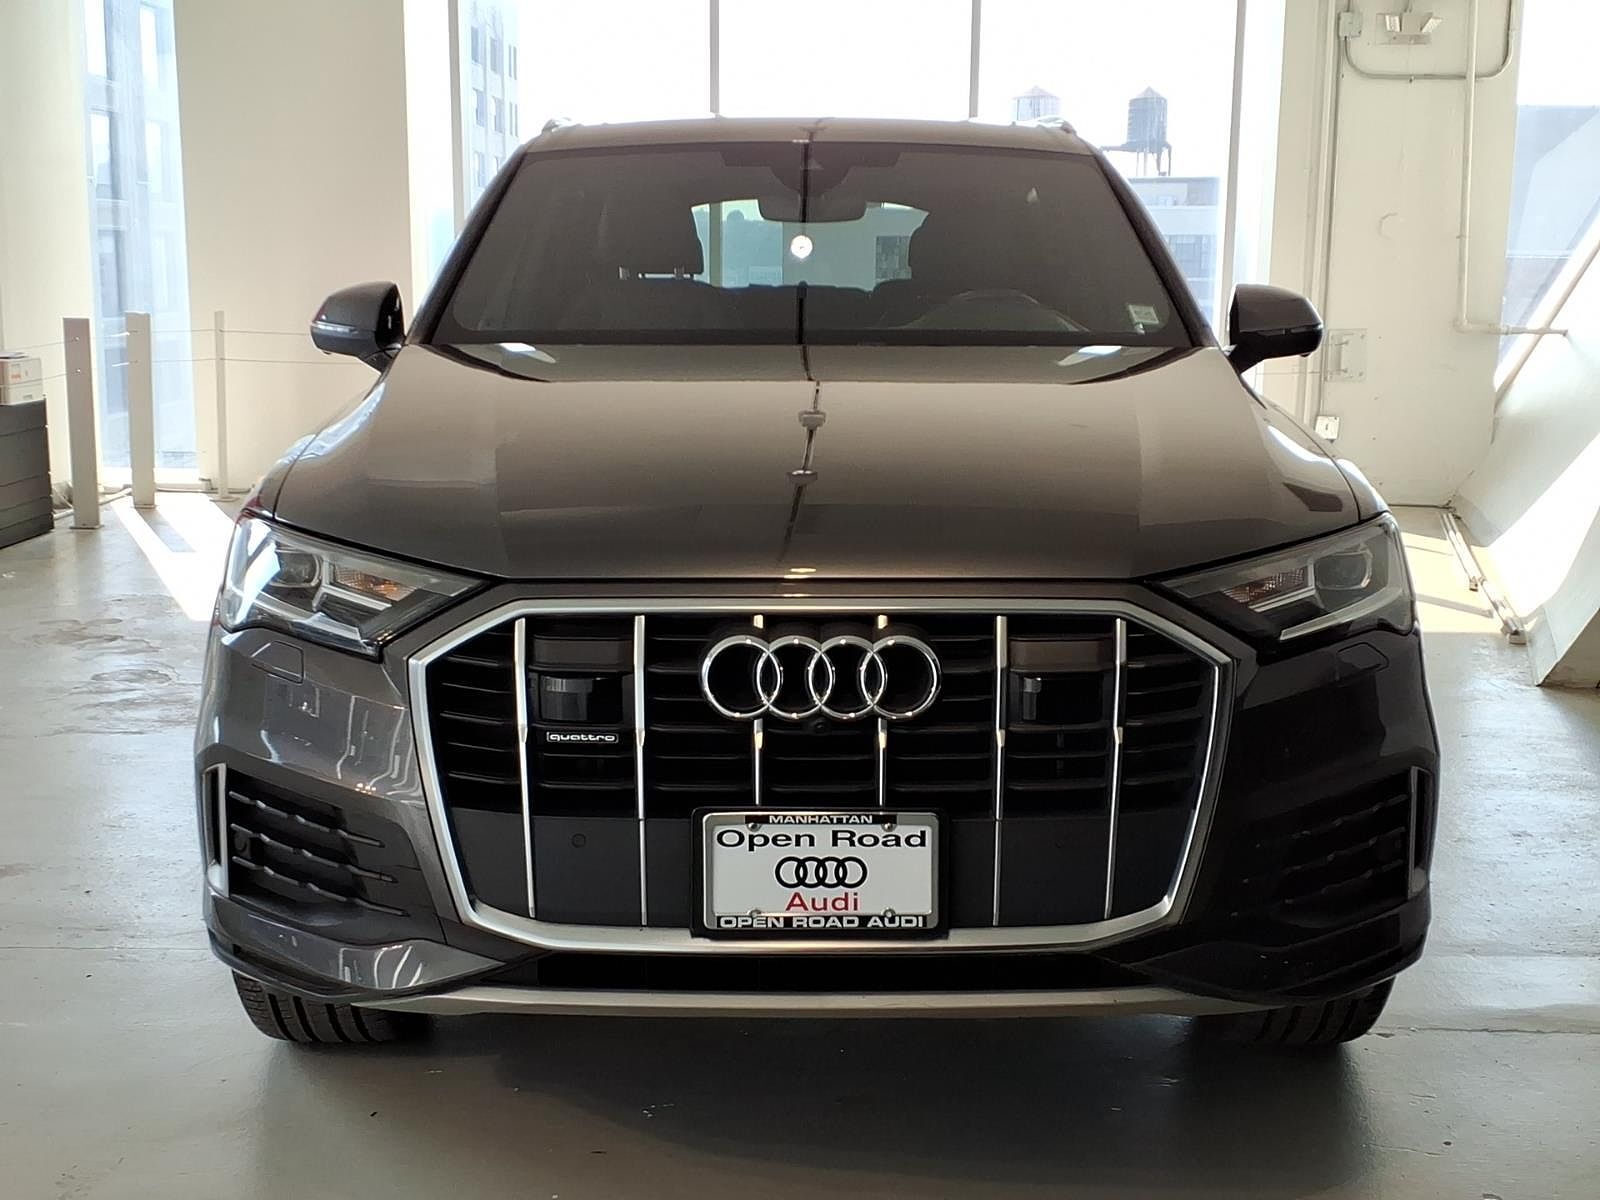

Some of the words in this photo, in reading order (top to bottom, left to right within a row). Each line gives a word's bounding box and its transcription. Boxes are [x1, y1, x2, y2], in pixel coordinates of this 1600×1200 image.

[549, 734, 616, 742] quattro
[769, 815, 873, 824] MANHATTAN
[716, 829, 816, 852] Open
[831, 830, 927, 848] Road
[785, 892, 859, 911] Audi
[719, 916, 788, 928] OPEN
[792, 916, 860, 928] ROAD
[867, 916, 924, 928] AUDI
